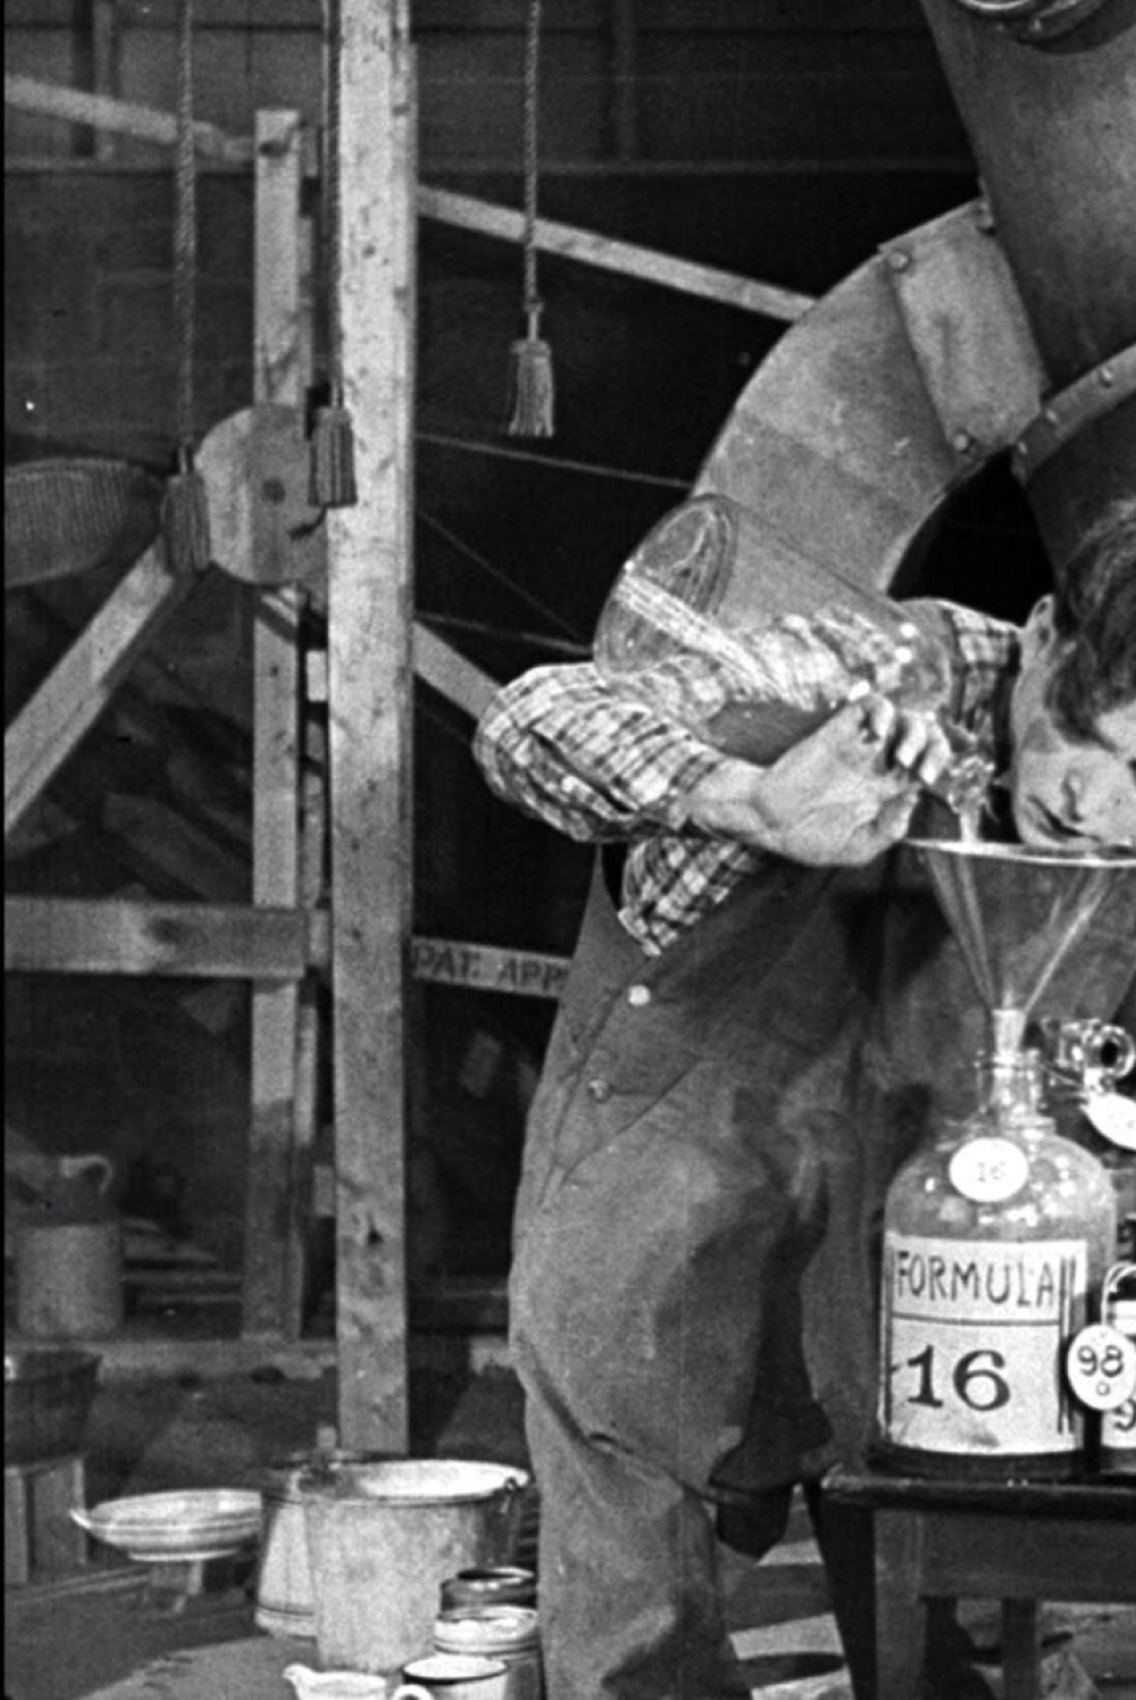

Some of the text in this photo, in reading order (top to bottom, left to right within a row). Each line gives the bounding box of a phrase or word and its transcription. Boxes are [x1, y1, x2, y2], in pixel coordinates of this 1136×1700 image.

[896, 1250, 1056, 1307] FORMULA
[907, 1344, 1011, 1411] 16
[1076, 1344, 1125, 1378] 98
